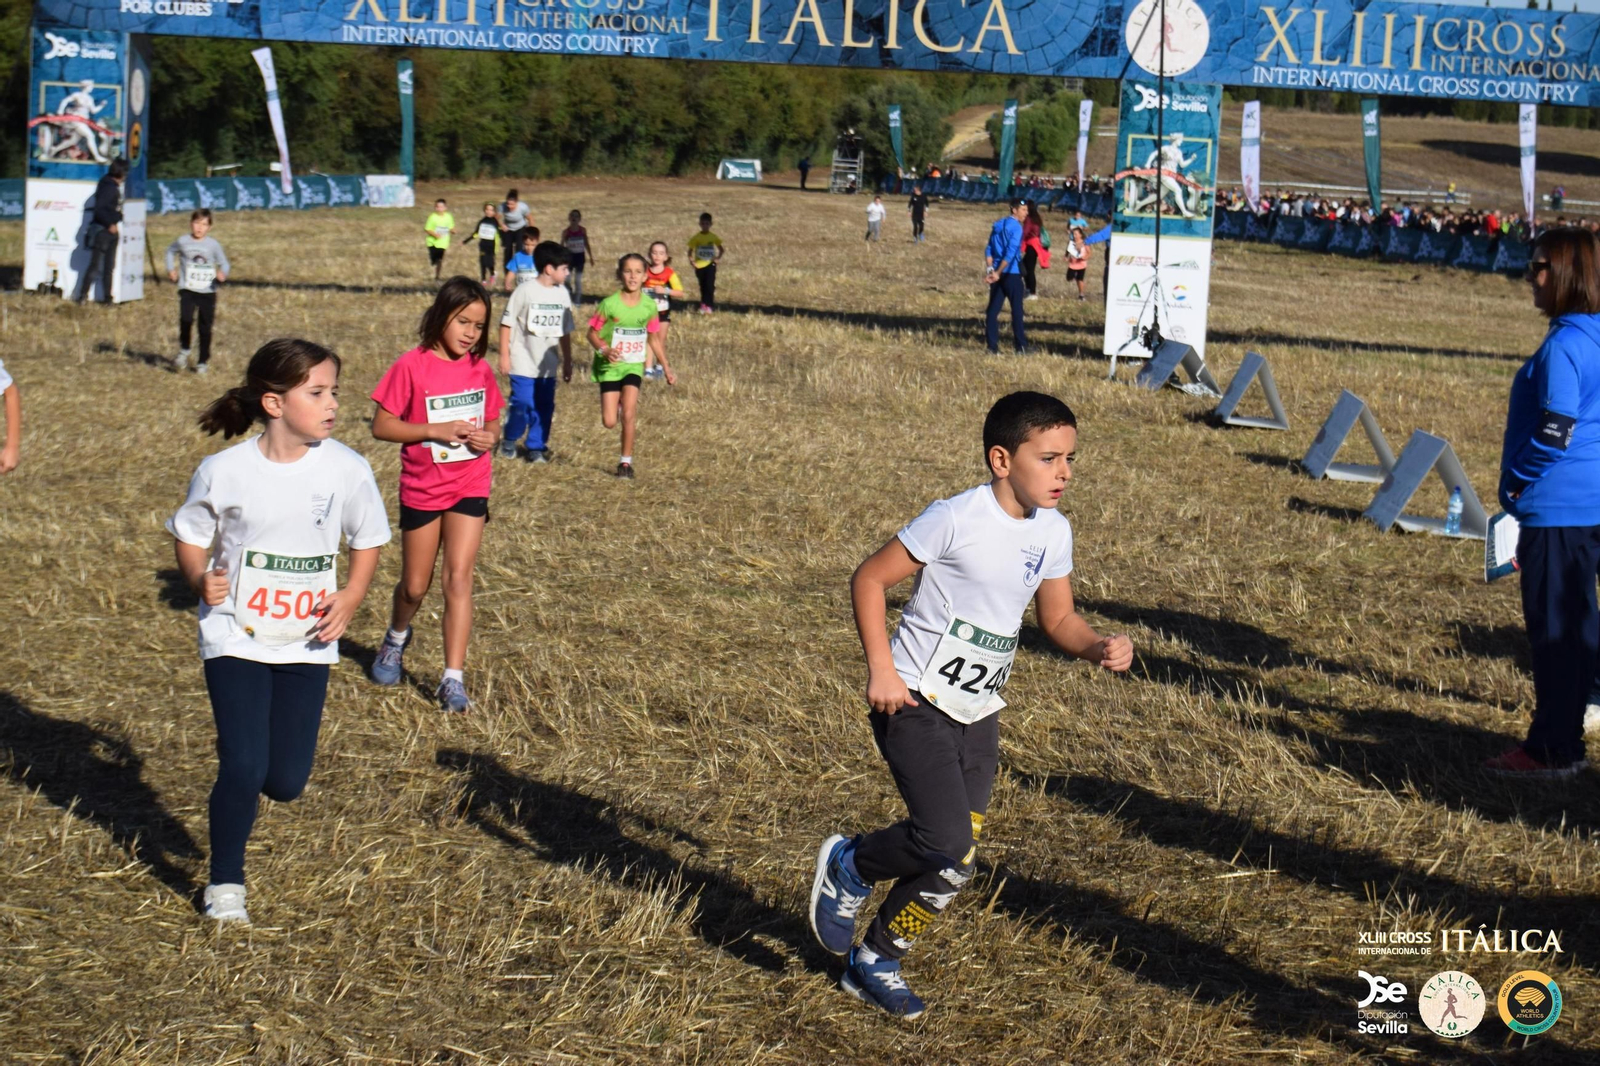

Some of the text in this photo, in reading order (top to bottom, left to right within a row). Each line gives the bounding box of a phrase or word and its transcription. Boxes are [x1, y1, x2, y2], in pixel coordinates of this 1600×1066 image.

[120, 1, 213, 17] POR CLUBES
[513, 10, 691, 34] INTERNACIONAL
[342, 25, 660, 54] INTERNATIONAL CROSS COUNTRY
[1254, 6, 1567, 71] XLIII CROSS
[1431, 54, 1600, 82] INTERNACIONA
[1252, 66, 1580, 102] INTERNATIONAL CROSS COUNTRY
[1171, 101, 1208, 113] Sevilla
[531, 314, 562, 327] 4202
[615, 341, 644, 354] 4395
[273, 557, 319, 571] ITÁLICA
[978, 634, 1016, 651] ITÁLIC
